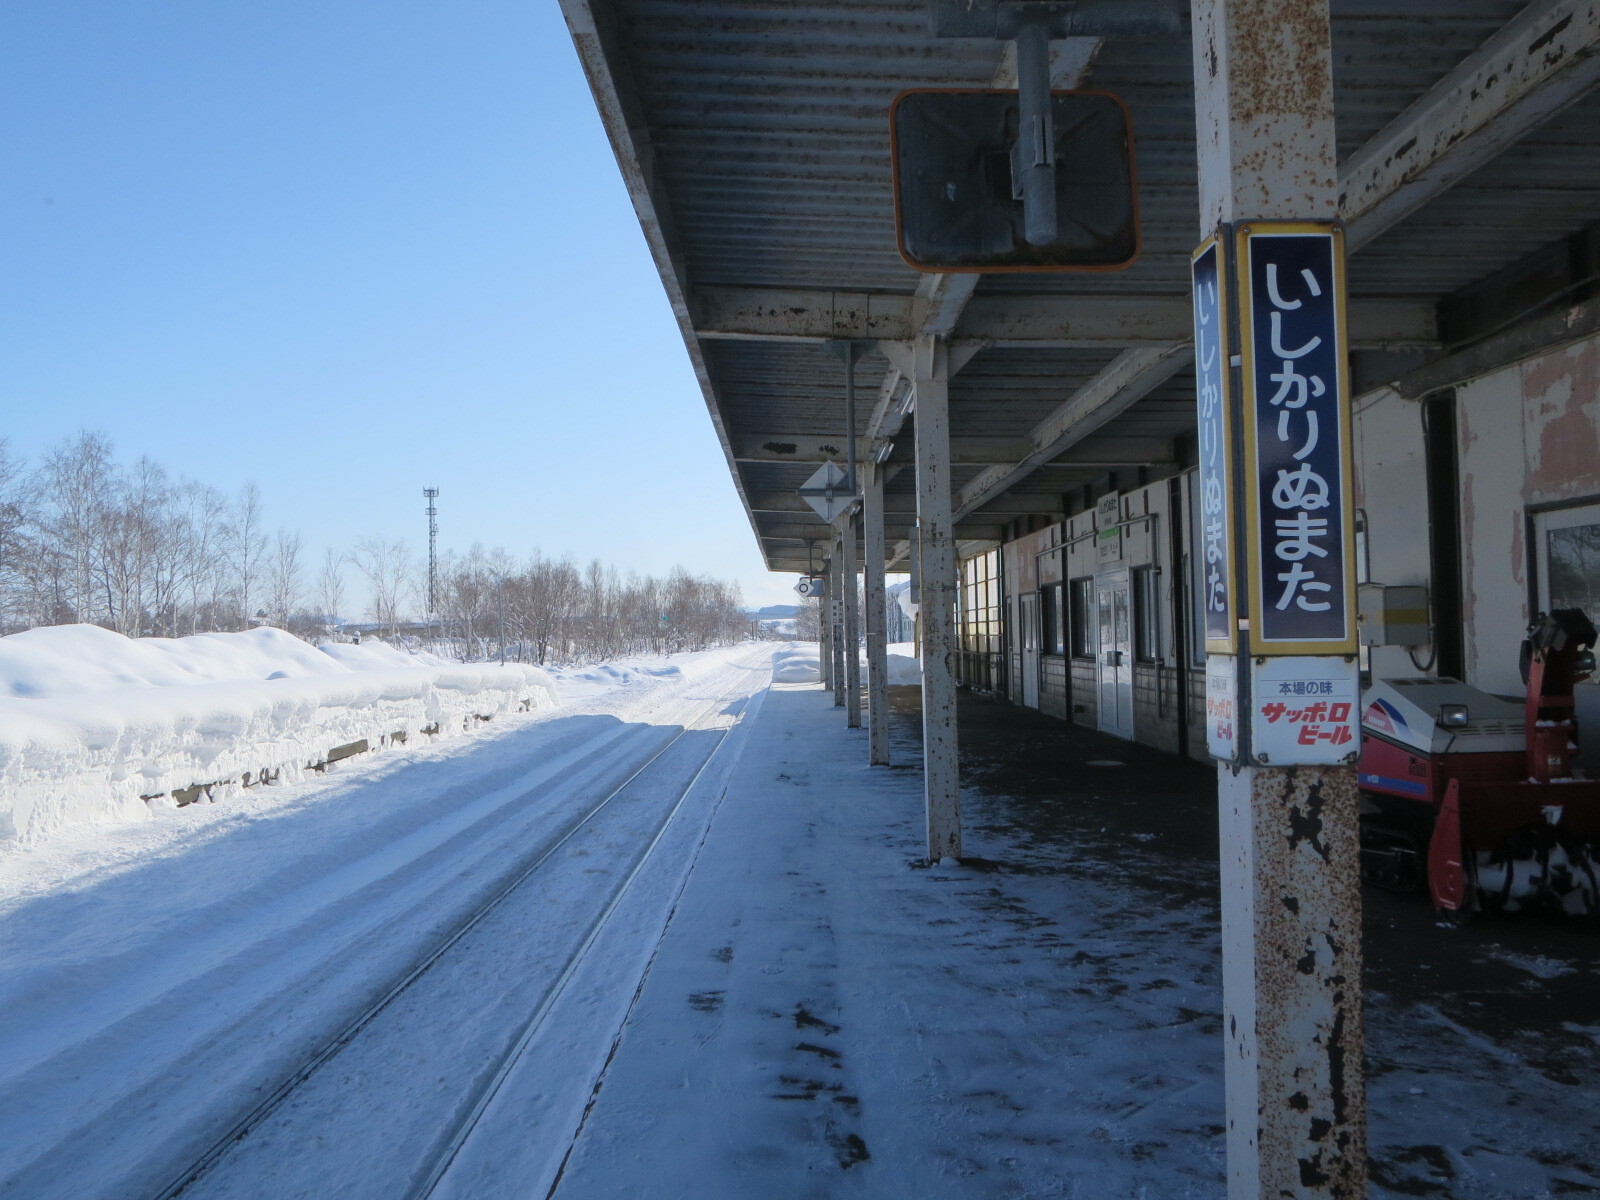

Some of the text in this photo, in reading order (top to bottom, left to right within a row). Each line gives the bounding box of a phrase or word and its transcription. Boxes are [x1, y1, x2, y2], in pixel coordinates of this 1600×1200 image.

[1198, 282, 1224, 612] いしかりぬまた
[1267, 263, 1331, 612] いしかりぬまた
[1279, 681, 1333, 695] 本場の味
[1261, 701, 1352, 723] サッポロ
[1297, 725, 1352, 745] ビール
